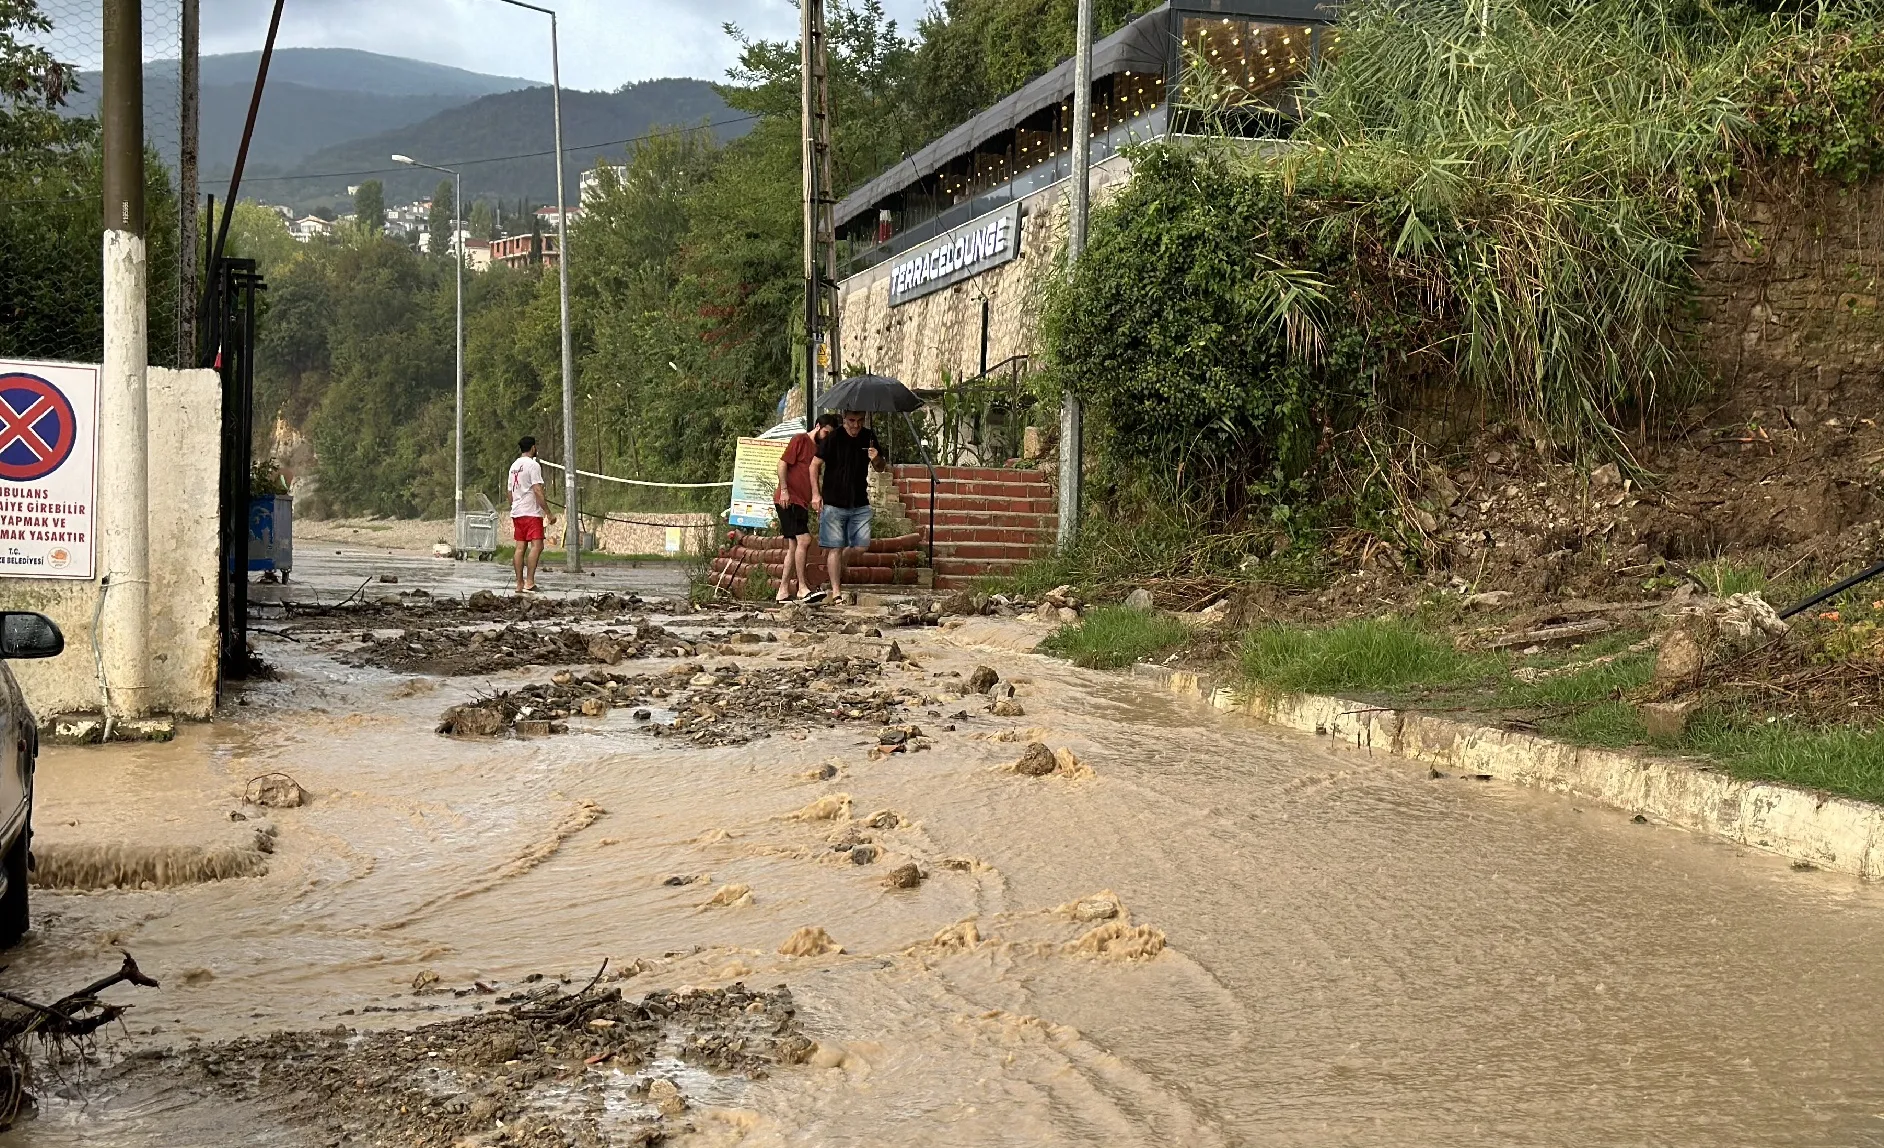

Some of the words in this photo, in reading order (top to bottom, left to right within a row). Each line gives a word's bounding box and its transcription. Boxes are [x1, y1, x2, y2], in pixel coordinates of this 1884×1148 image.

[0, 487, 48, 499] BULANS
[27, 500, 85, 514] GİREBİLİR
[1, 515, 48, 527] YAPMAK
[53, 518, 66, 528] VE
[30, 531, 85, 542] YASAKTIR
[7, 556, 44, 565] BELEDİYESİ
